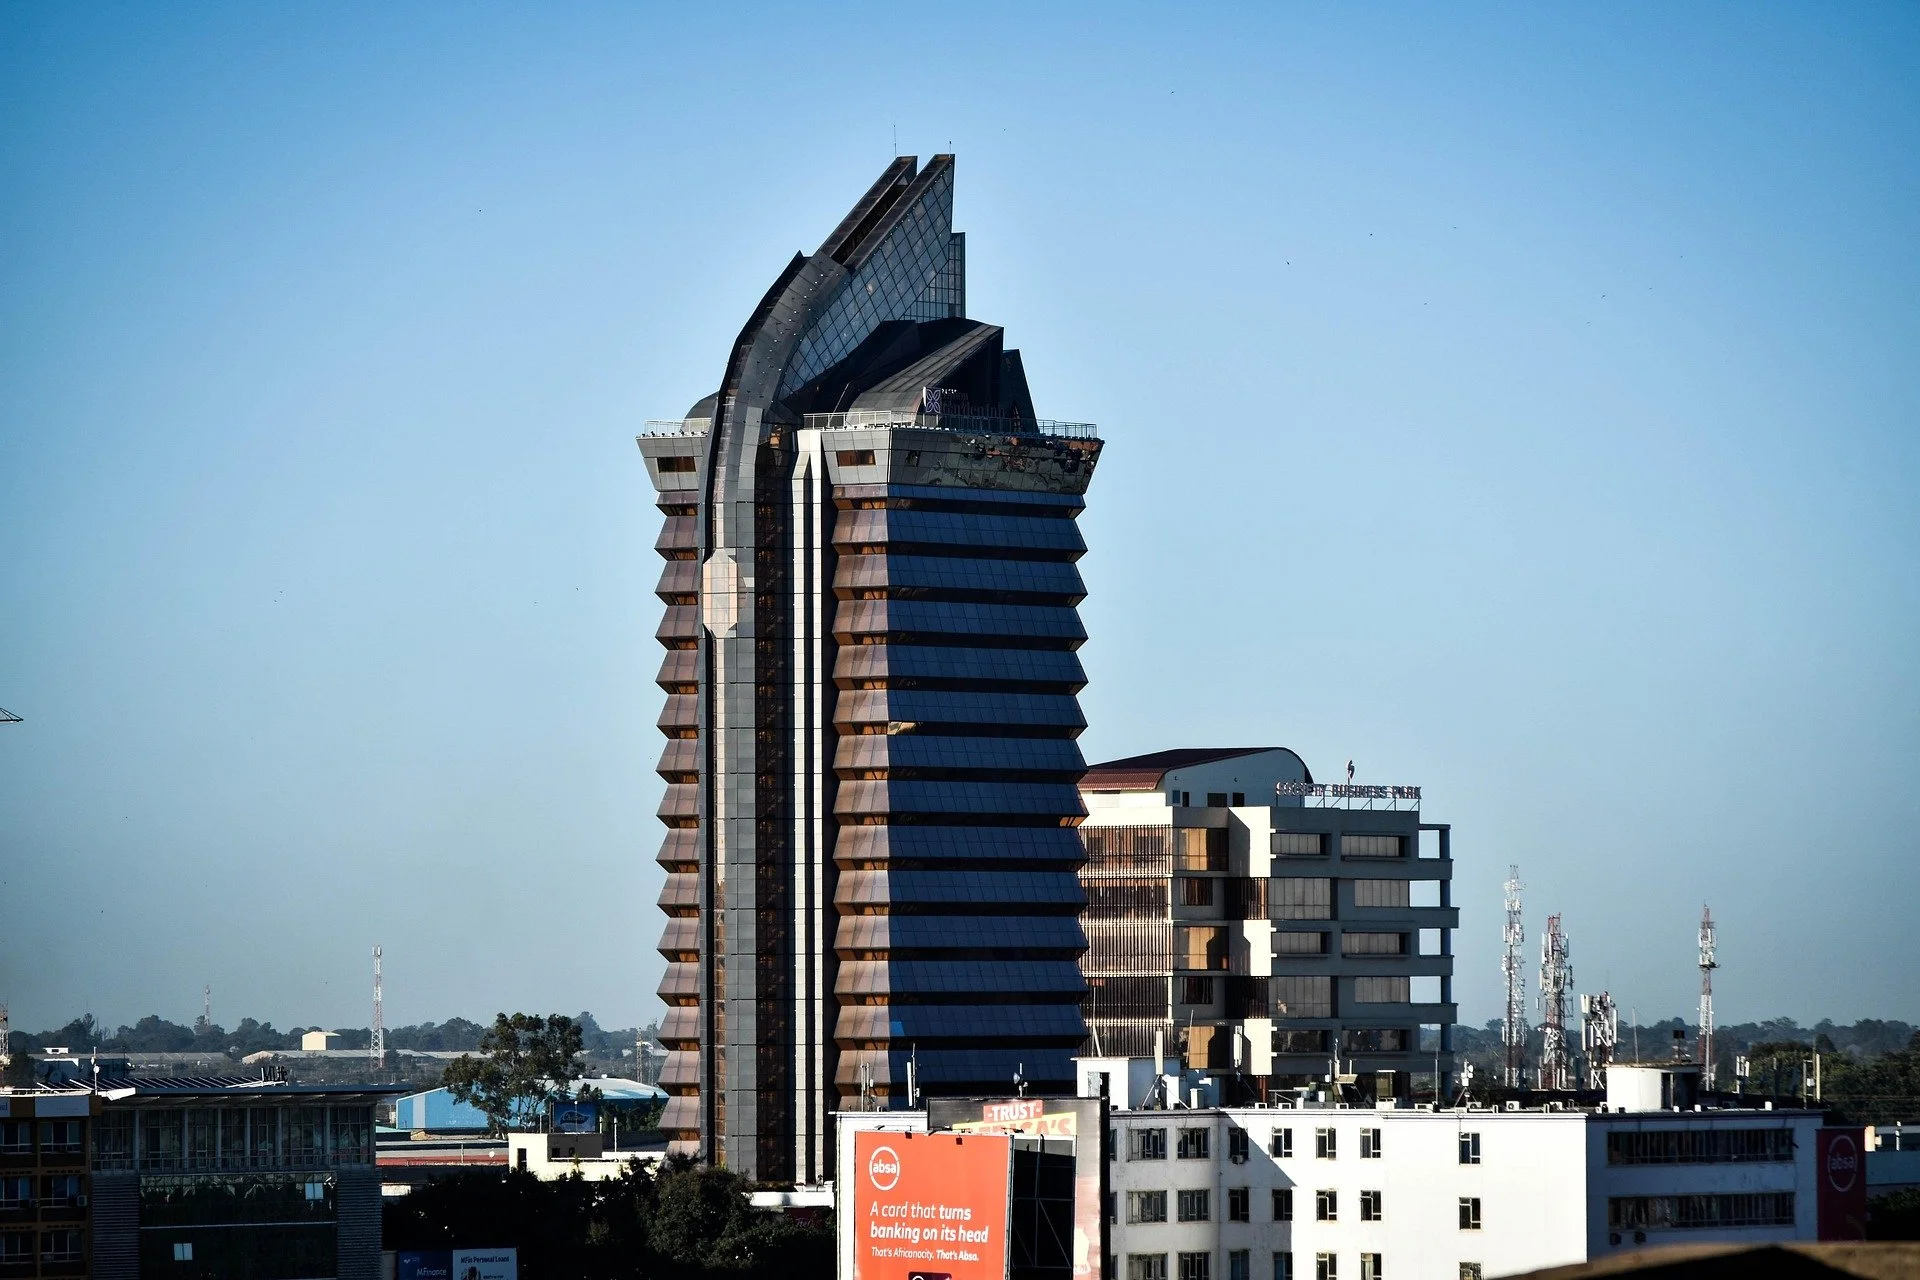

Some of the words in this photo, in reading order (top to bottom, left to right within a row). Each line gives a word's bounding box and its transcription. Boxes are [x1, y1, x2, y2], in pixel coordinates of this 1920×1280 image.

[1332, 784, 1387, 799] BUSINESS
[1391, 786, 1421, 799] PARK
[873, 1159, 897, 1173] absa
[1830, 1152, 1855, 1170] absa
[870, 1201, 879, 1216] A
[881, 1201, 908, 1218] card
[911, 1202, 936, 1219] that
[939, 1205, 971, 1220] turns
[870, 1221, 920, 1244] banking
[923, 1227, 937, 1240] on
[941, 1224, 956, 1242] its
[958, 1225, 989, 1243] head
[872, 1247, 892, 1257] That's
[936, 1249, 957, 1260] That's
[958, 1250, 979, 1261] Absa.
